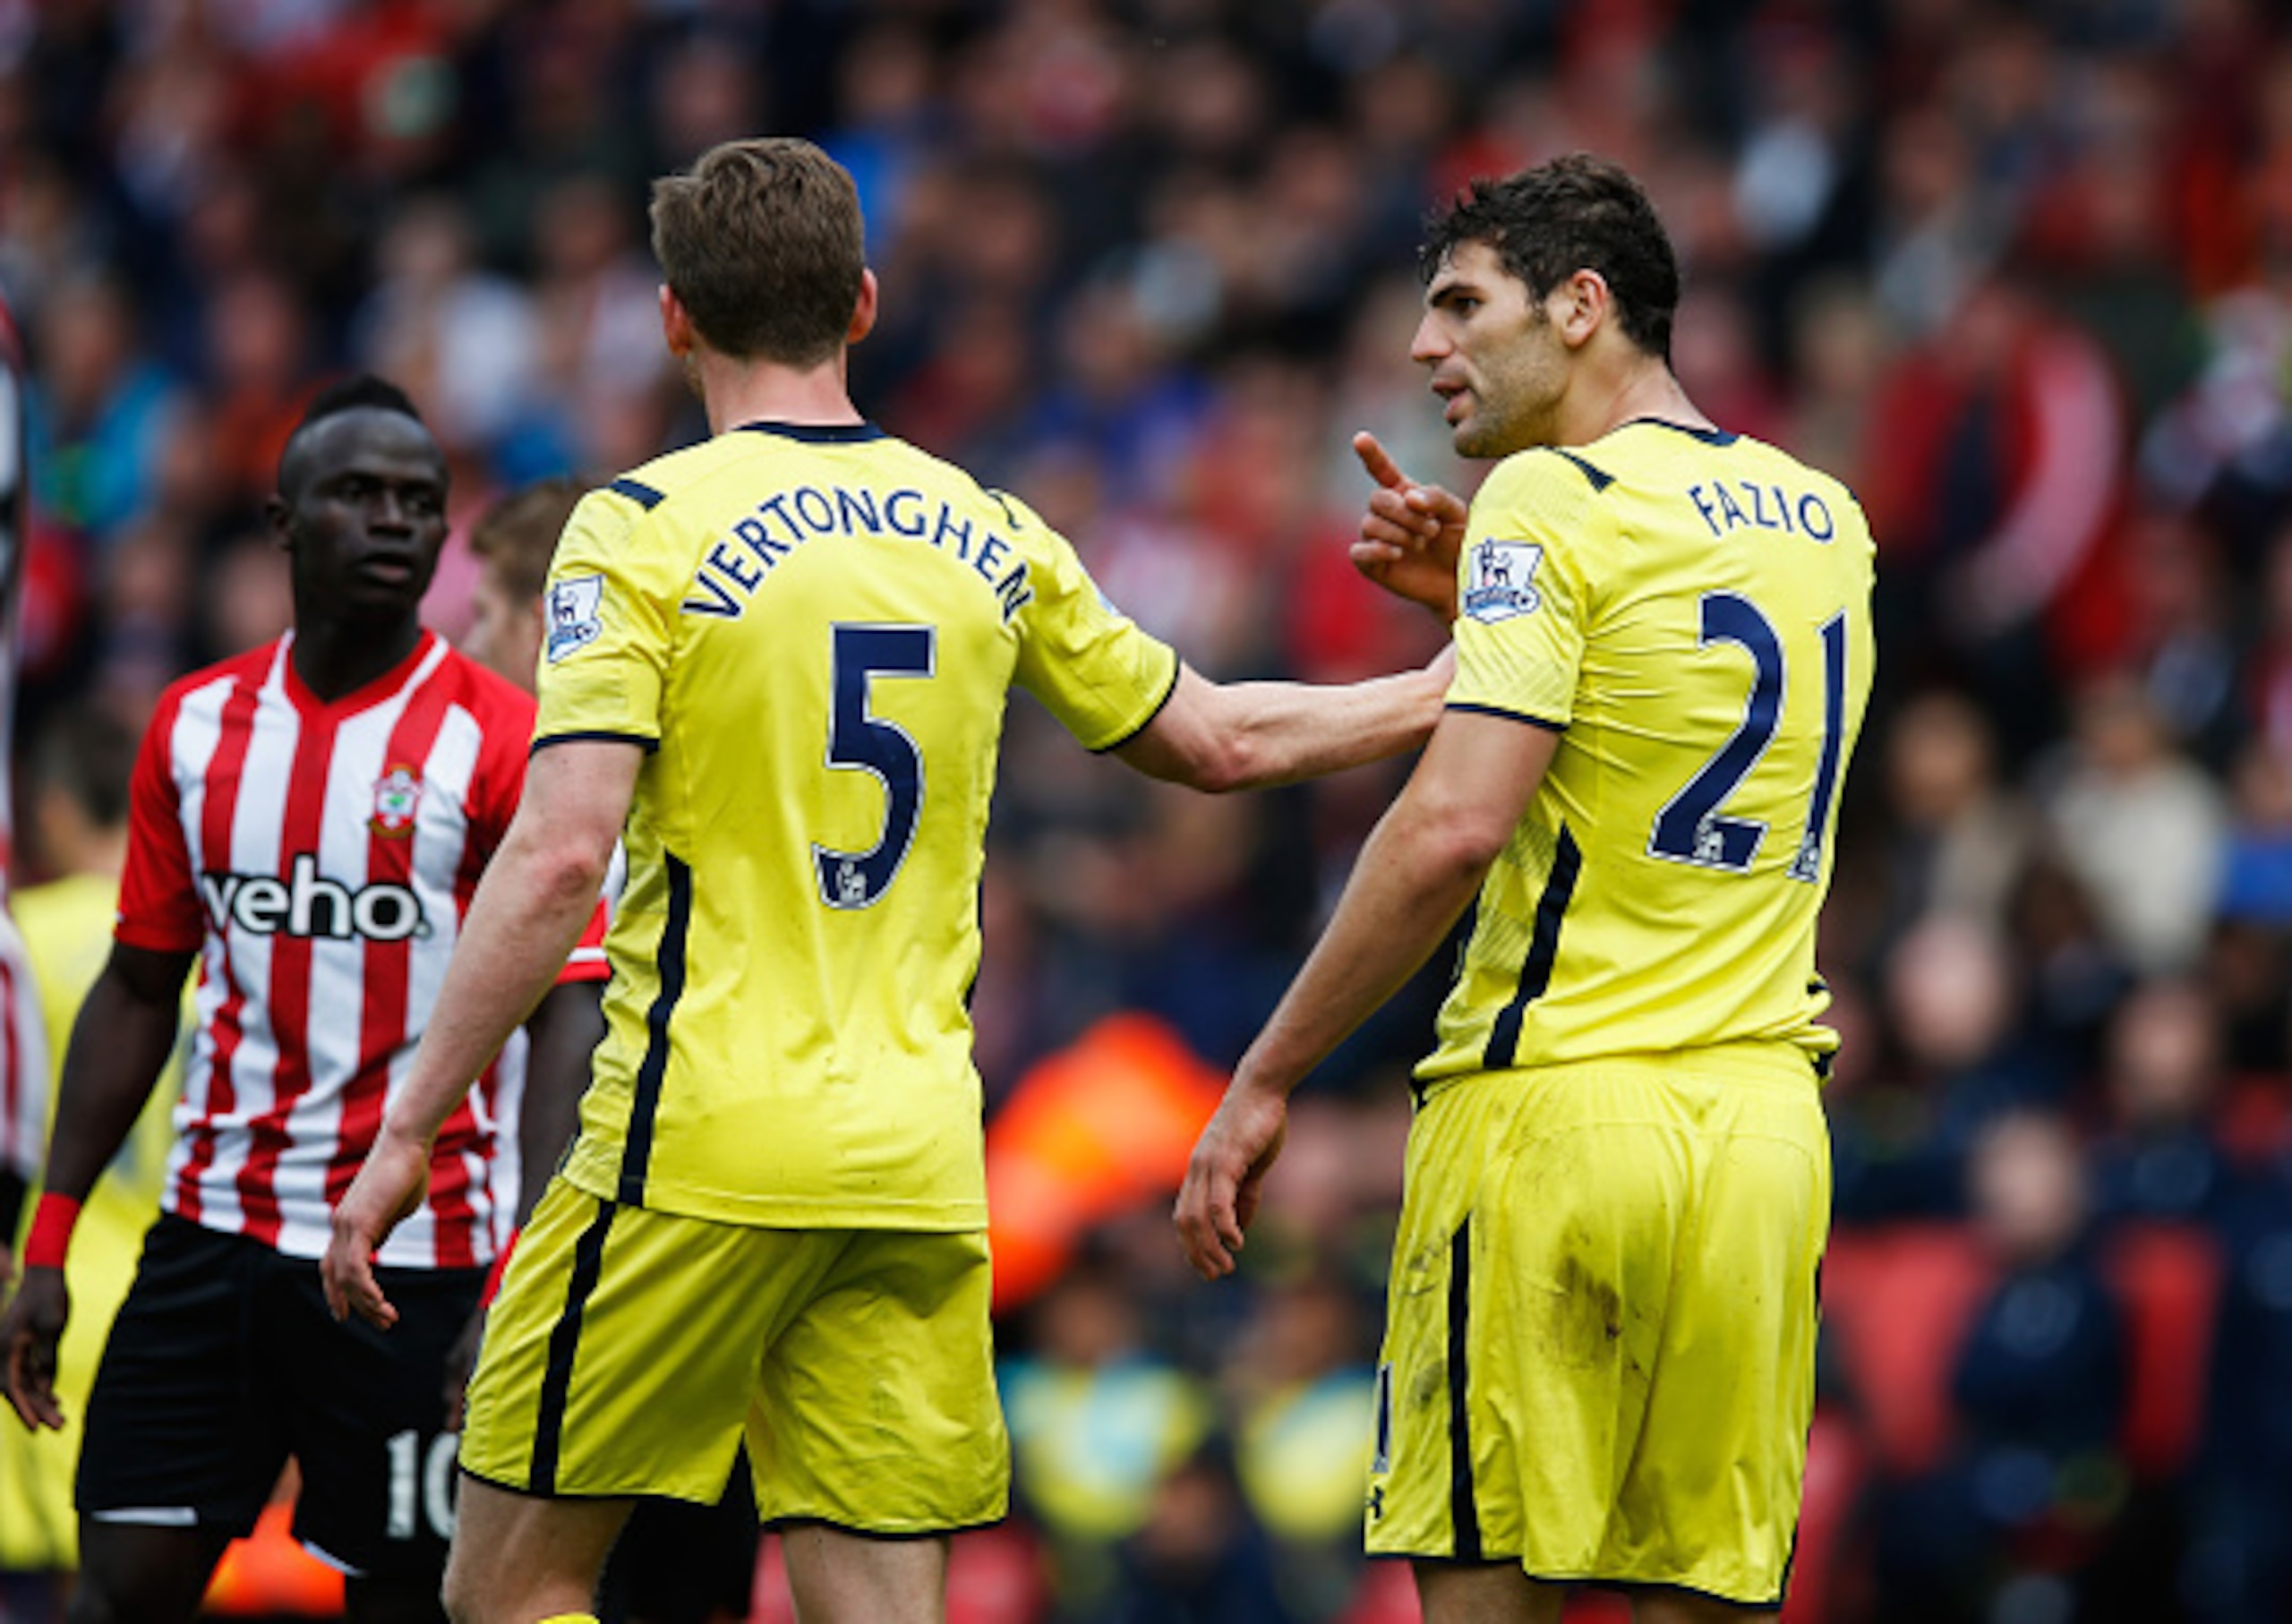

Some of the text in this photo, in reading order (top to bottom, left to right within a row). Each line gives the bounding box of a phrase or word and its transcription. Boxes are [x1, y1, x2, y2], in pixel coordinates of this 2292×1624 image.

[680, 485, 1035, 623] VERTONGHEN
[1687, 480, 1835, 544] FAZIO
[811, 621, 936, 910] 5
[1646, 587, 1850, 884] 21
